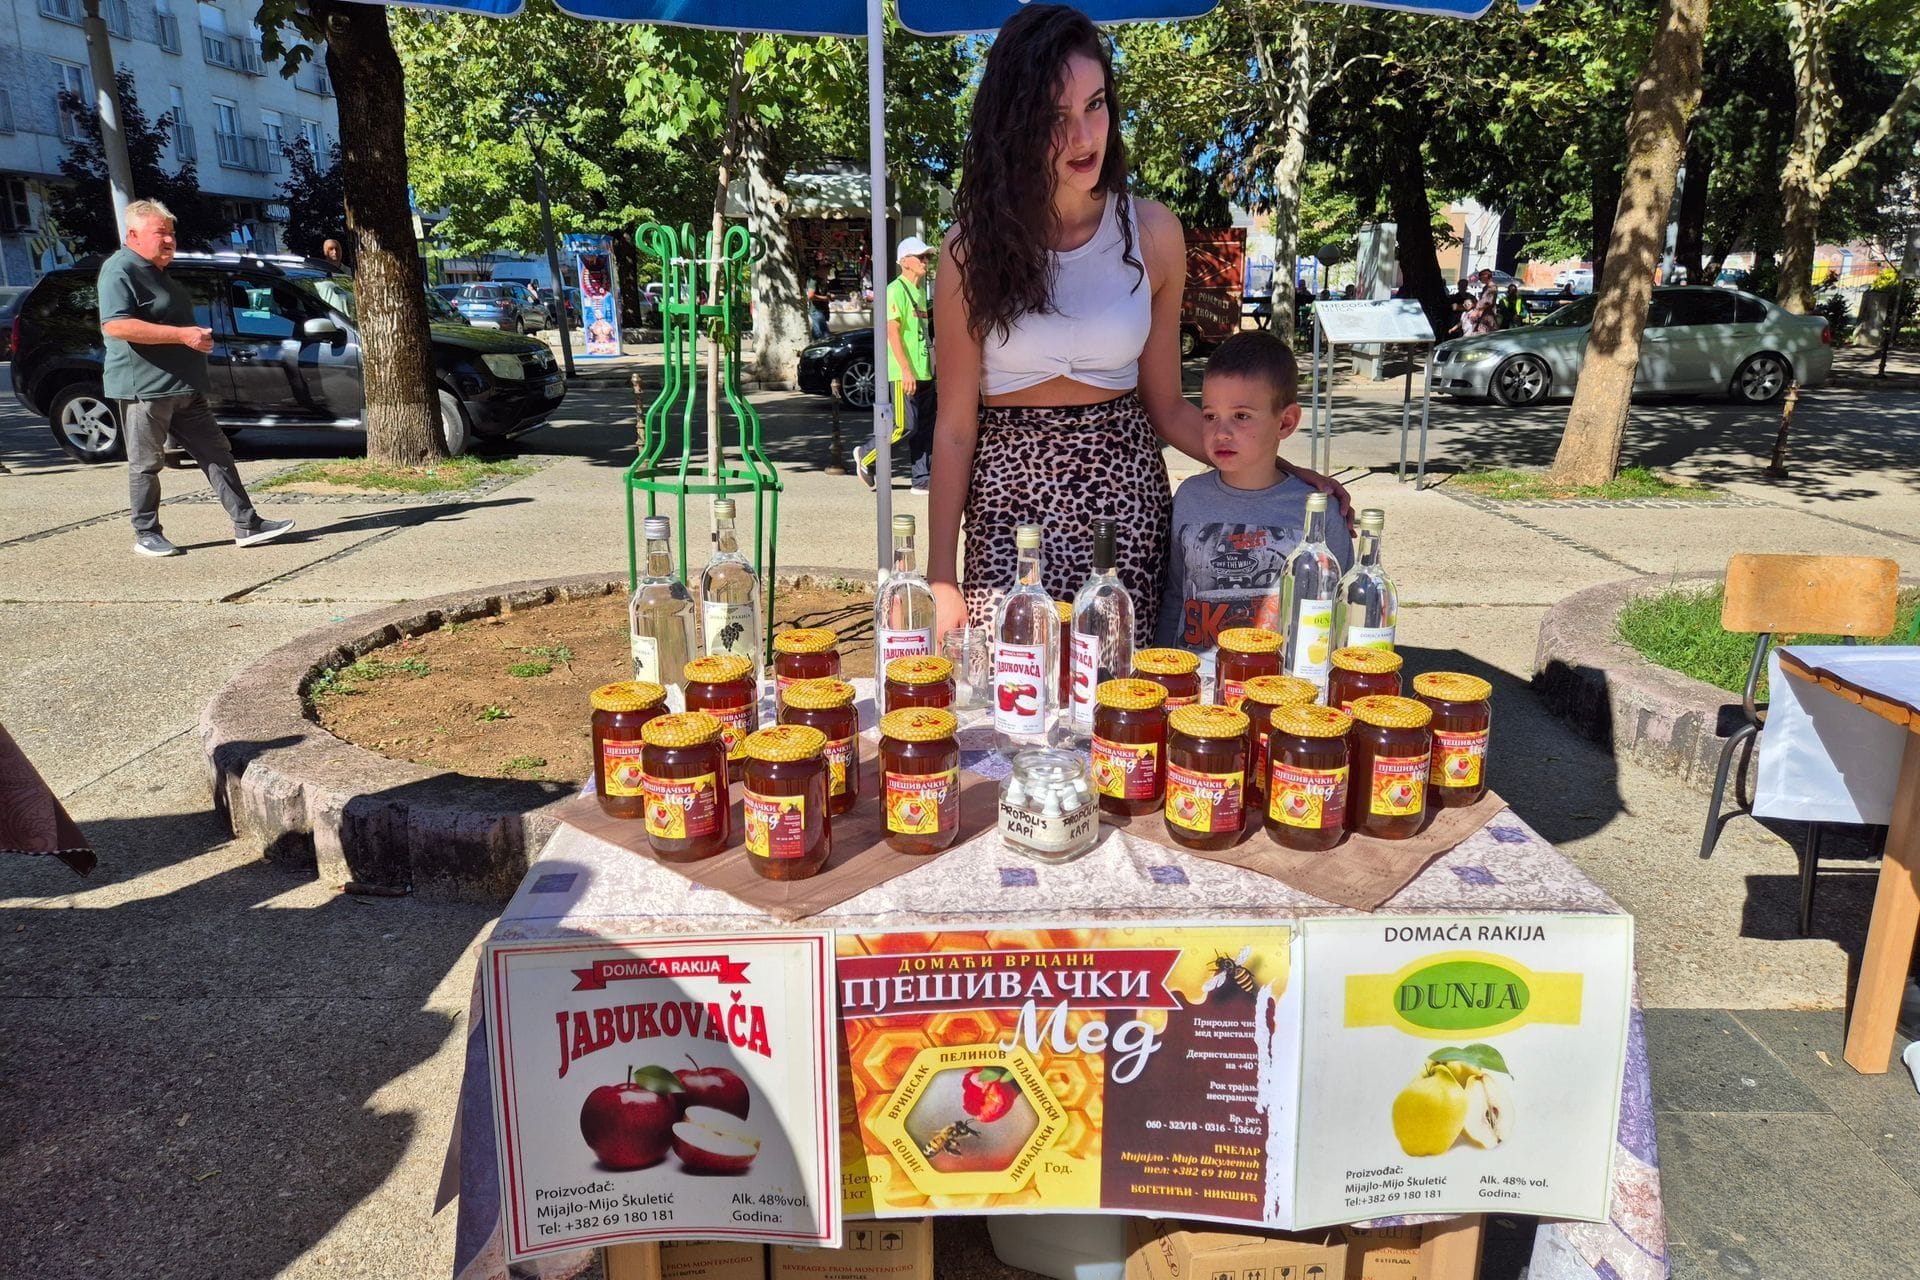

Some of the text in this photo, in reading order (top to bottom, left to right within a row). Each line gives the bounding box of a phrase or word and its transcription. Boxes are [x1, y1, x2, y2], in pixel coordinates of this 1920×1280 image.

[266, 204, 291, 218] JUNIOR
[995, 661, 1042, 678] JABUKOVAČA
[1000, 803, 1048, 829] PROPOLIS
[1384, 923, 1546, 943] DOMAĆA RAKIJA
[602, 959, 721, 978] DOMAĆA RAKIJA
[898, 953, 1095, 974] ДОМАЋИ ВРЦАНИ
[841, 970, 1151, 1013] ПЈЕШИВАЧКИ
[1400, 982, 1524, 1012] DUNJA
[1193, 1017, 1239, 1029] Природно
[555, 990, 772, 1079] JABUKOVAČA
[999, 999, 1162, 1084] Мед
[940, 1050, 1007, 1063] ПЕЛИНОВ
[888, 1064, 930, 1120] ВРИЈЕСАК
[1013, 1058, 1061, 1122] ПЛАНИНСКИ
[1209, 1081, 1226, 1090] Рок
[1204, 1123, 1226, 1133] 0316
[1234, 1125, 1263, 1136] 1364/2
[1011, 1125, 1056, 1183] ЛИВАДСКИ
[1214, 1144, 1261, 1156] ПЧЕЛАР
[1044, 1162, 1073, 1175] Год.
[1171, 1153, 1198, 1166] Мијо
[1200, 1154, 1260, 1169] Шкулетић
[841, 1174, 883, 1185] Нето:
[1172, 1167, 1199, 1177] +382
[1201, 1168, 1214, 1178] 69
[1217, 1170, 1236, 1179] 180
[1240, 1171, 1258, 1182] 181
[1345, 1165, 1404, 1180] Proizvođač:
[1345, 1175, 1448, 1194] Mijajlo-Mijo Škuletić
[1479, 1175, 1549, 1188] Alk. 48% vol.
[535, 1181, 615, 1201] Proizvođač:
[1204, 1189, 1258, 1202] НИКШИЋ
[1388, 1192, 1400, 1202] 69
[1403, 1191, 1421, 1200] 180
[1424, 1190, 1442, 1199] 181
[1478, 1188, 1521, 1199] Godina:
[536, 1192, 675, 1220] Mijajlo-Mijo Škuletić
[731, 1193, 757, 1205] Alk.
[538, 1210, 675, 1236] Tel: +382 69 180 181
[732, 1210, 782, 1224] Godina:
[692, 1256, 753, 1268] MONTENEGRO
[782, 1263, 914, 1273] BEVERAGES FROM MONTENEGRO
